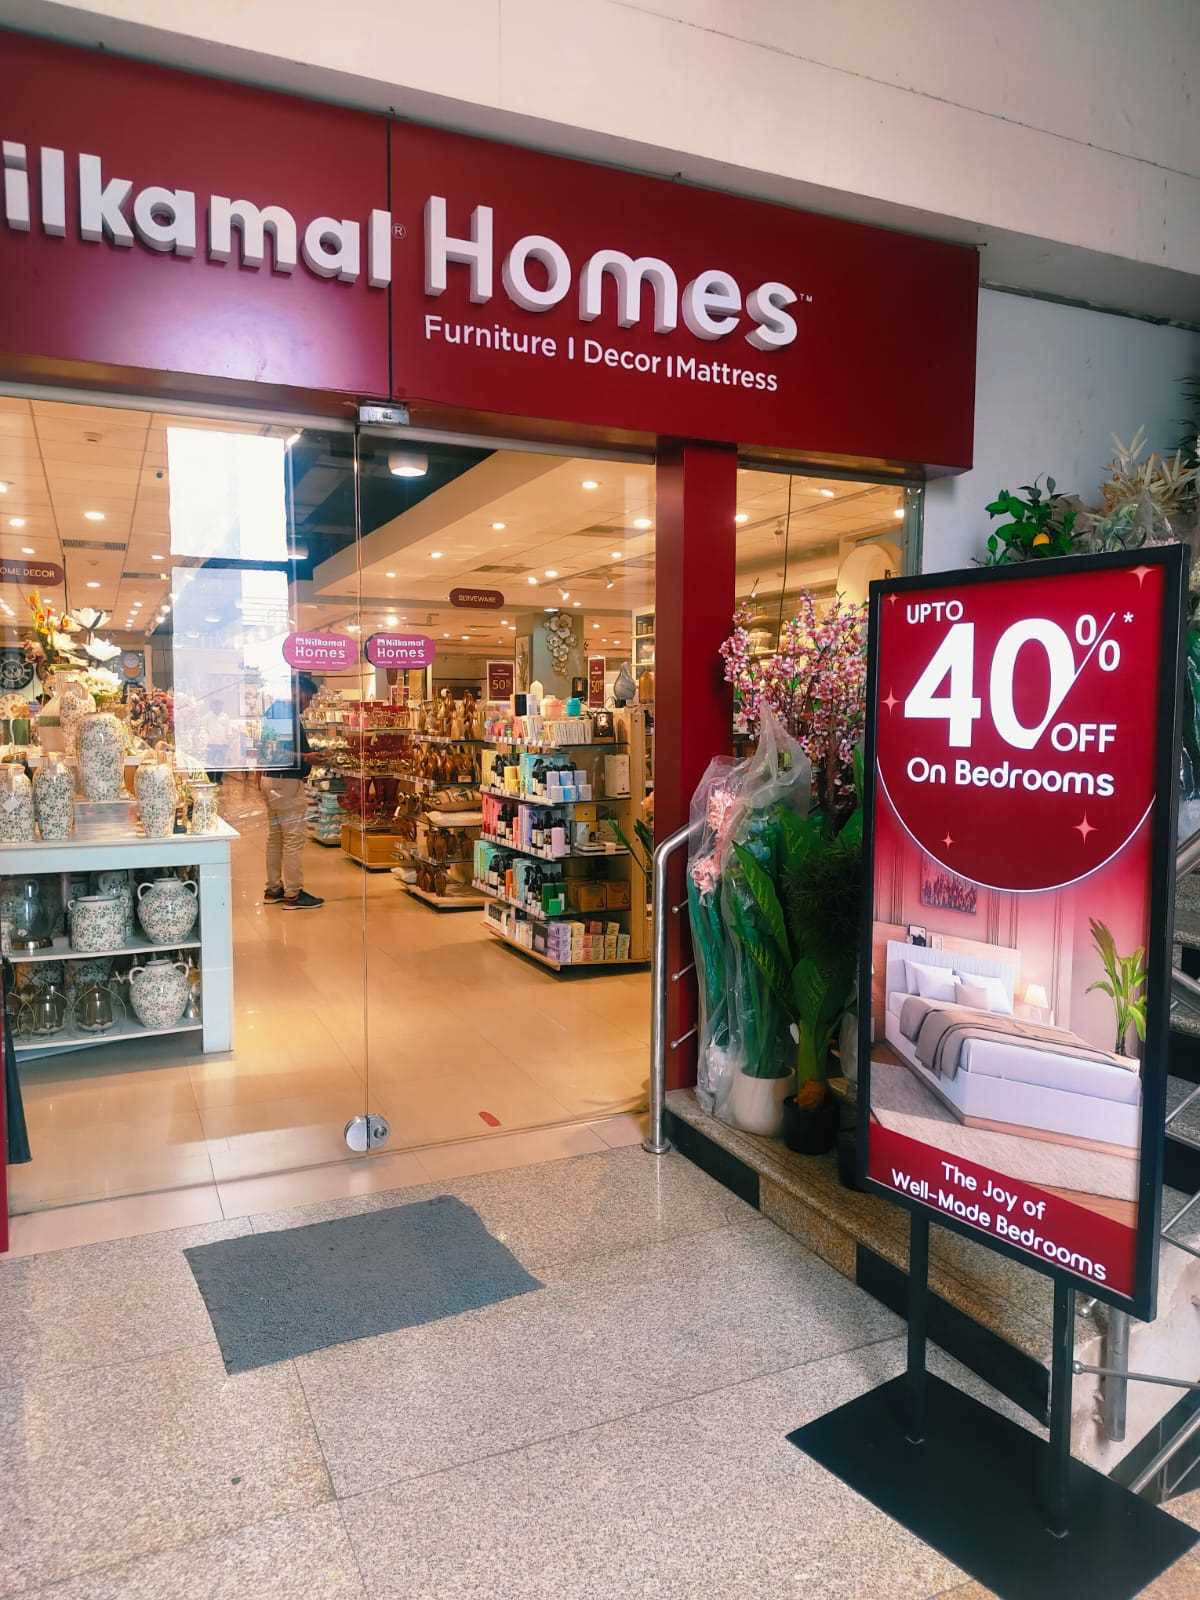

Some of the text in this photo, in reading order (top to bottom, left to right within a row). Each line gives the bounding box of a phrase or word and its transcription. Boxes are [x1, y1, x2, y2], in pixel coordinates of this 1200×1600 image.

[424, 195, 797, 351] Homes
[424, 314, 557, 357] Furniture
[584, 339, 661, 374] Decor
[676, 356, 778, 391] Mattress
[24, 567, 56, 578] DECOR
[906, 600, 964, 624] UPTO
[295, 646, 346, 659] Homes
[304, 637, 346, 647] Nilkamal
[377, 647, 425, 658] Homes
[385, 638, 425, 647] Nilkamal
[1051, 722, 1117, 753] OFF
[907, 756, 1115, 797] On Bedrooms
[941, 1161, 1047, 1220] The Joy of
[891, 1168, 1107, 1281] Well-Made Bedrooms
